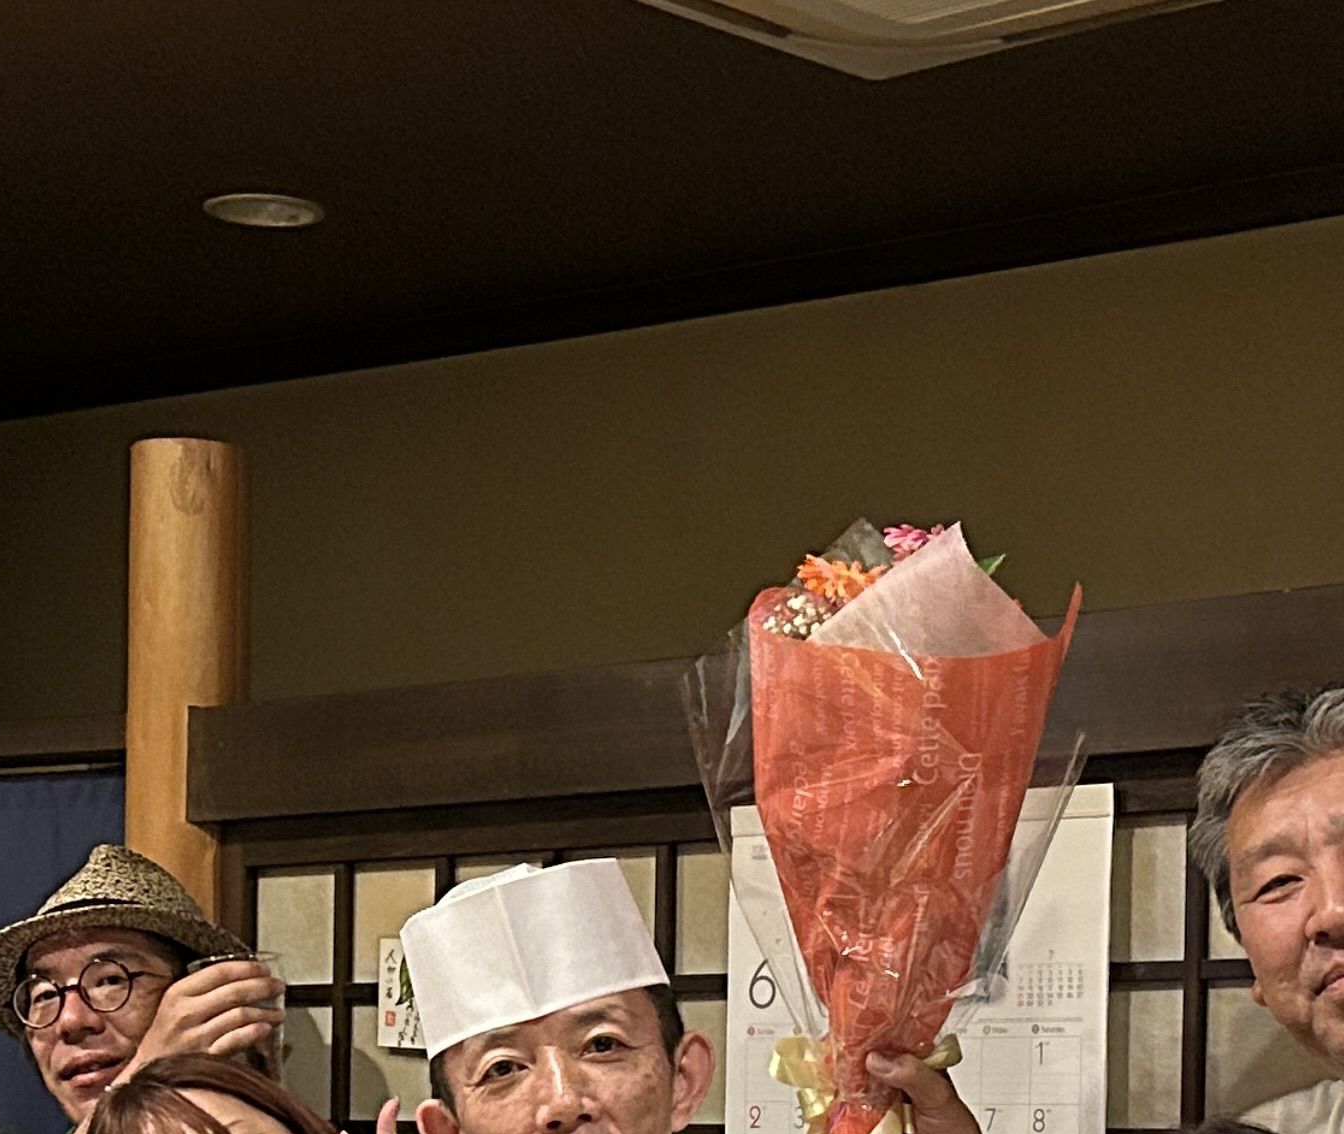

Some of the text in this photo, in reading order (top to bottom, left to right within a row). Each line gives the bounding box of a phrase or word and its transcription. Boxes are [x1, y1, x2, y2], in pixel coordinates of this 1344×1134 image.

[912, 717, 941, 785] Cette
[953, 819, 976, 880] nous
[748, 958, 776, 1009] 6
[1034, 1041, 1044, 1066] 1
[750, 1106, 1046, 1133] 2 3 7 8
